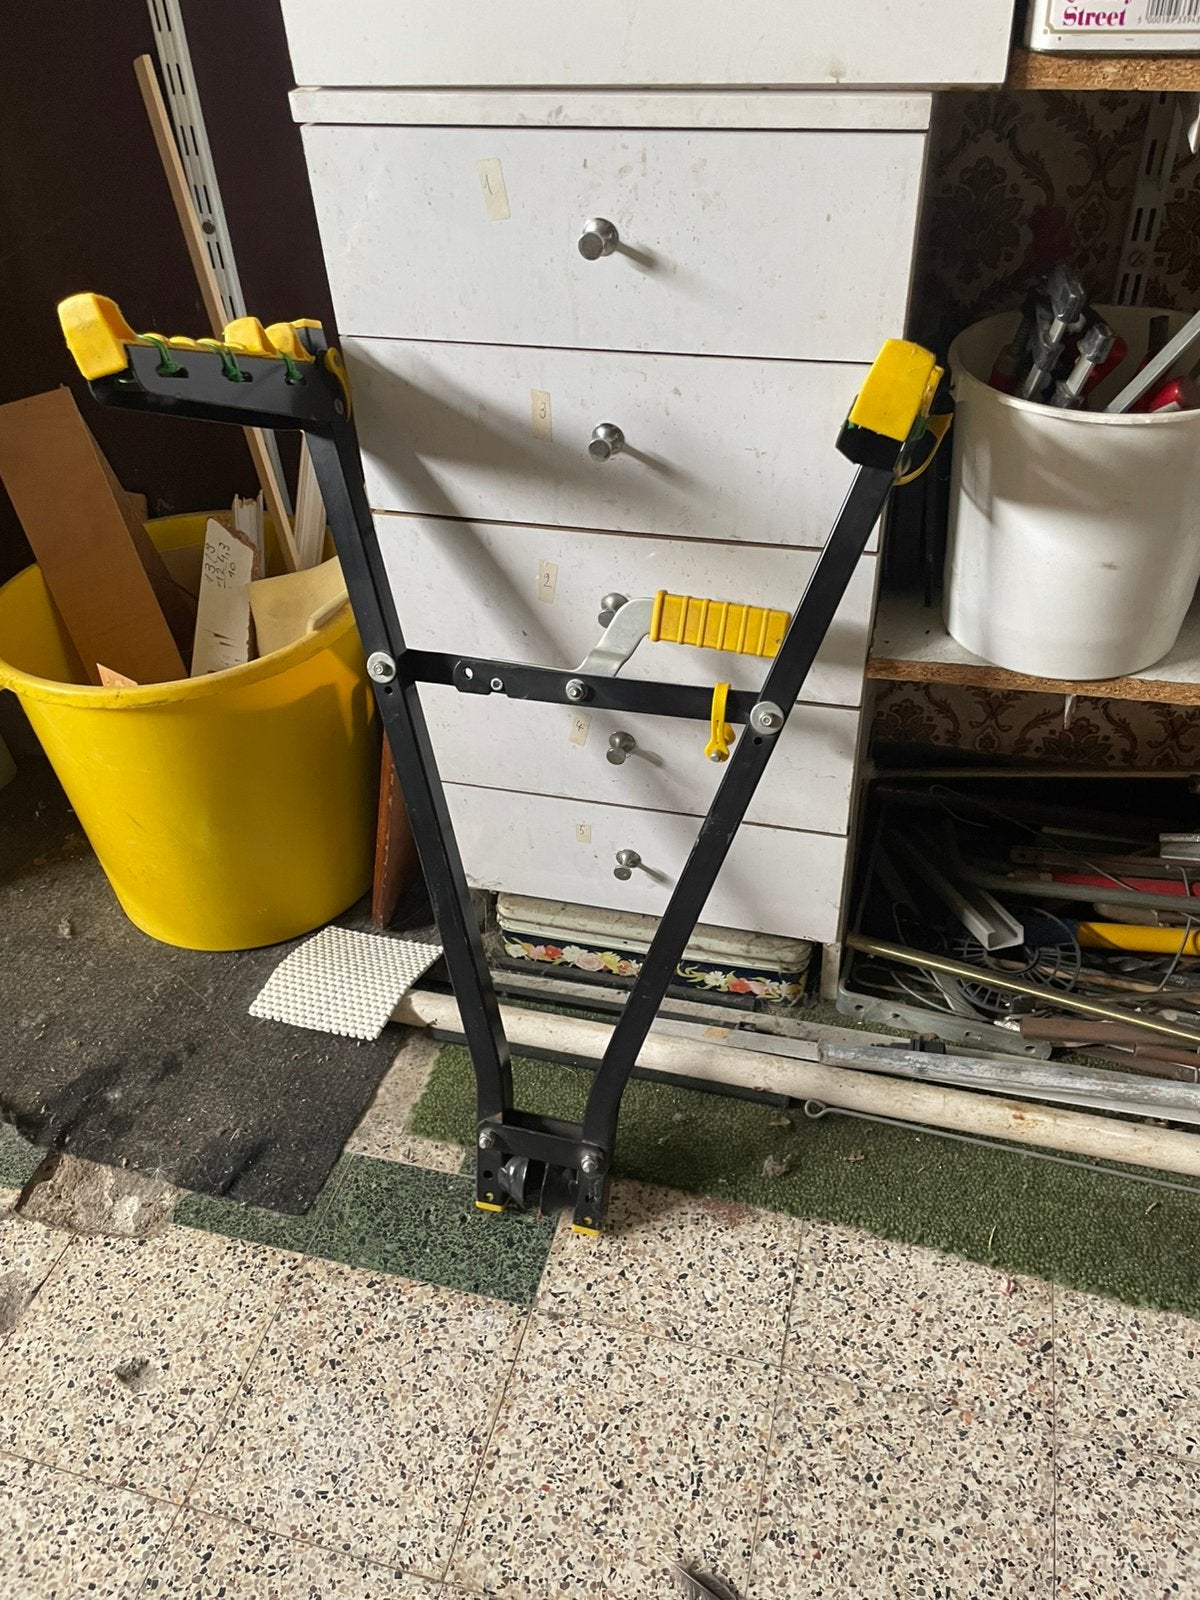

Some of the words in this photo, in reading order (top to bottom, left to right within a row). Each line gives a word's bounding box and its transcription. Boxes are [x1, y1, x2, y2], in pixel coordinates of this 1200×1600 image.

[1062, 6, 1127, 26] Street
[484, 173, 494, 196] 1
[538, 401, 547, 420] 3
[543, 573, 553, 589] 2
[575, 719, 585, 732] 4
[579, 824, 586, 836] 5
